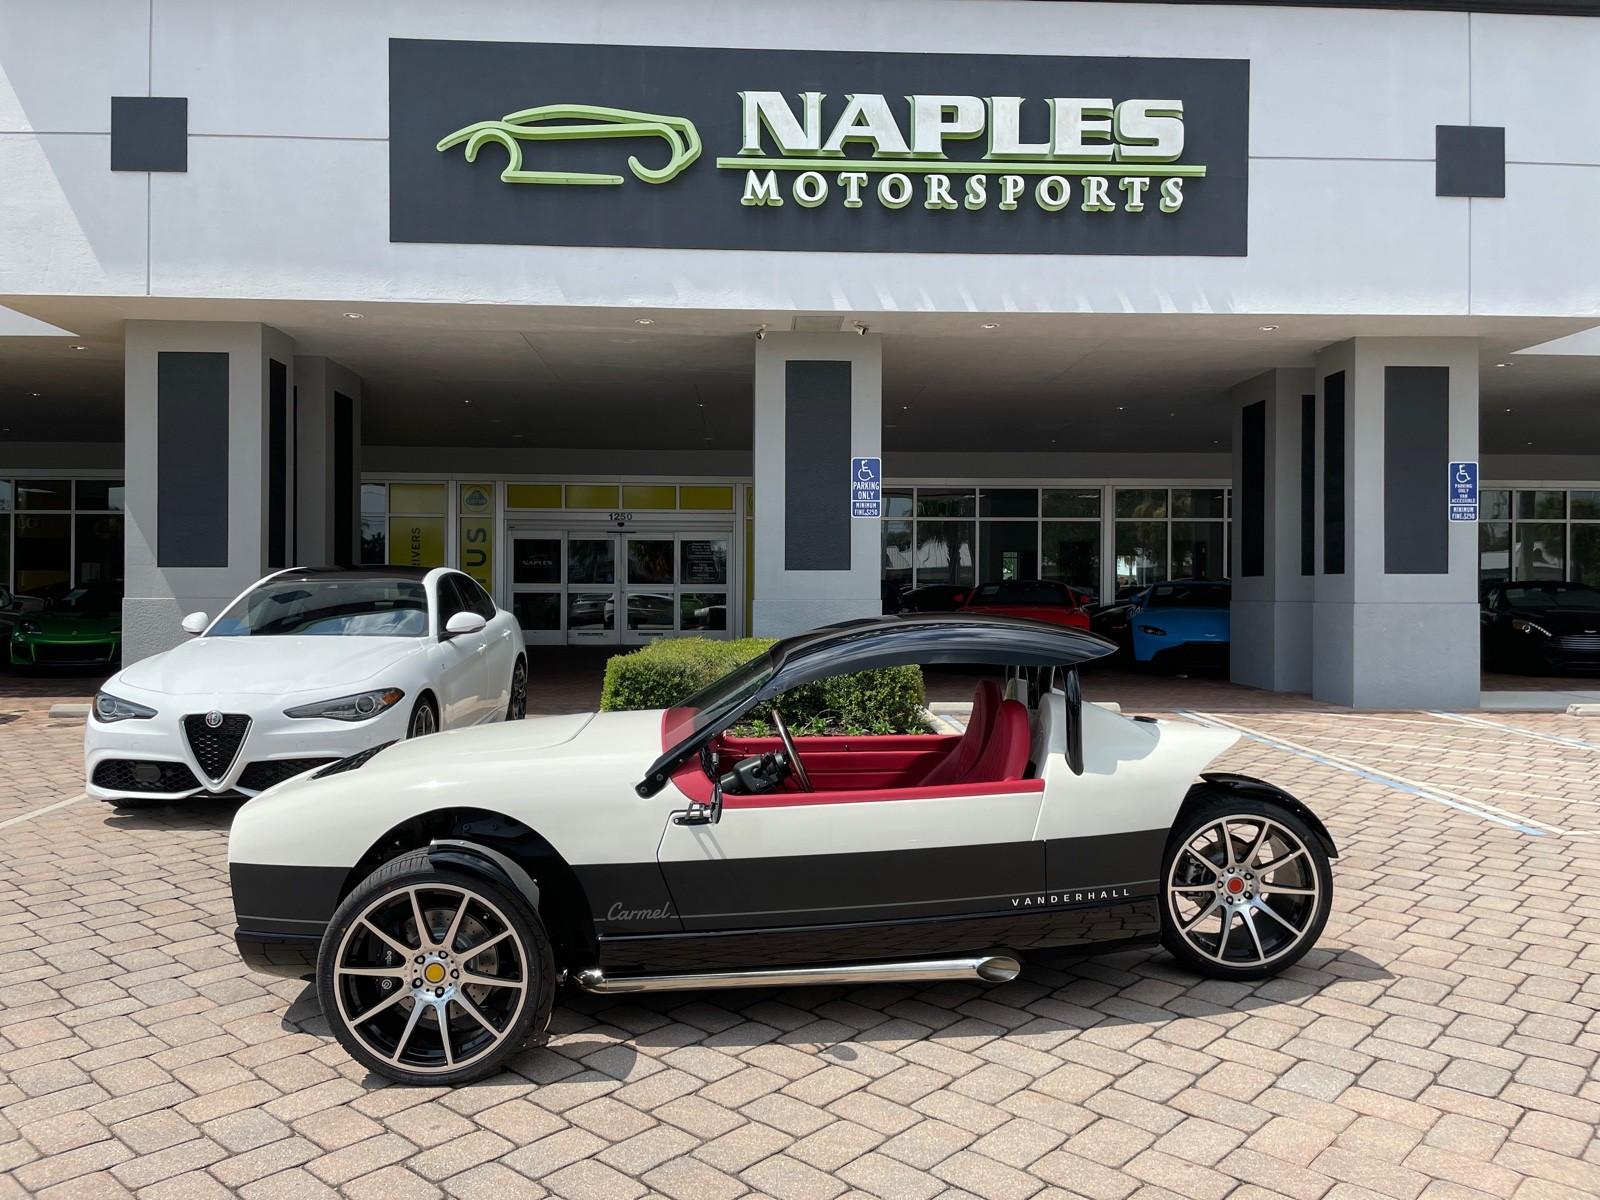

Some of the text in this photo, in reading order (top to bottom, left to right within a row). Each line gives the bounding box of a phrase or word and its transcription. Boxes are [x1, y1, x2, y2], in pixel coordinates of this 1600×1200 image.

[737, 90, 1186, 164] NAPLES
[740, 169, 1184, 214] MOTORSPORTS
[853, 481, 880, 490] PARKING
[858, 491, 875, 499] ONLY
[609, 512, 632, 521] 1250
[1011, 888, 1130, 907] VANDERHALL
[607, 901, 671, 921] Carmel
